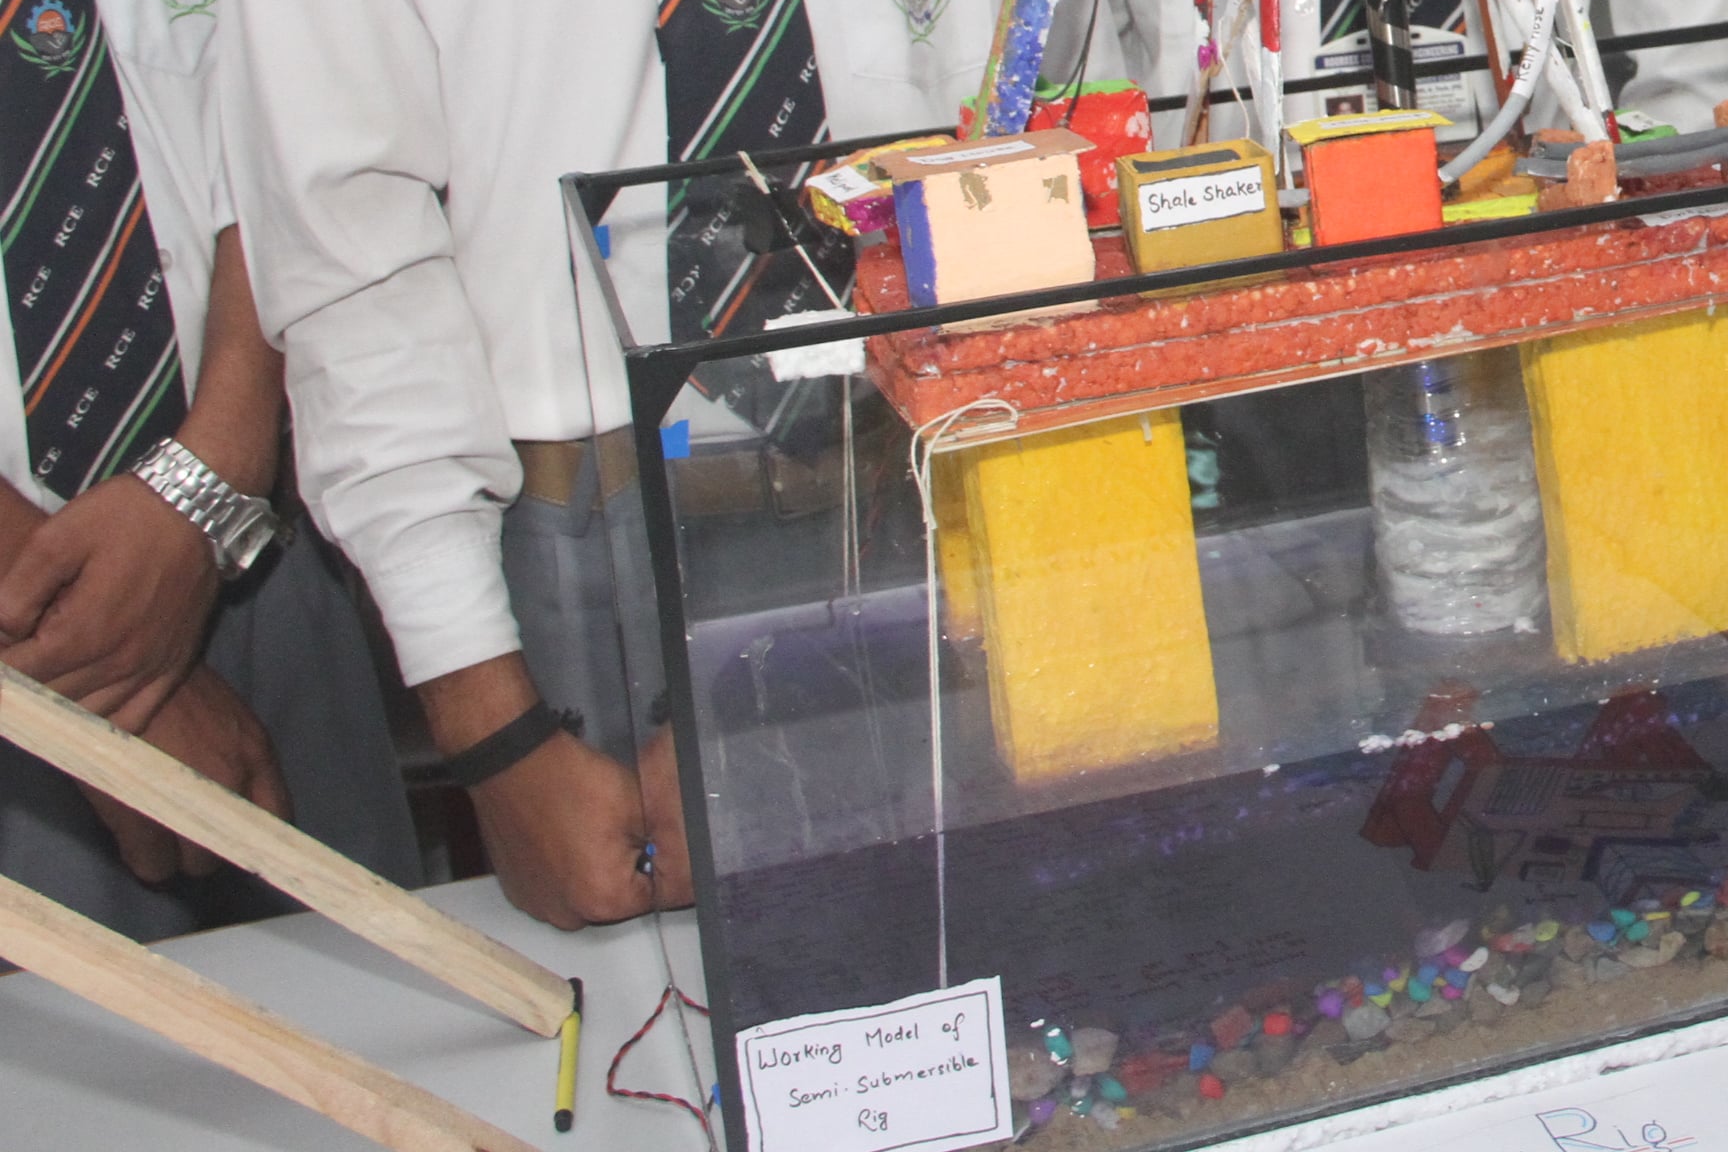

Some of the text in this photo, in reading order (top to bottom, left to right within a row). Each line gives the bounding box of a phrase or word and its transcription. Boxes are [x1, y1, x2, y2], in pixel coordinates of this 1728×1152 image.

[768, 96, 796, 138] RCE
[87, 145, 117, 189] RCE
[1147, 180, 1264, 215] Shale Shaker
[54, 204, 85, 248] RCE
[22, 265, 52, 309] RCE
[137, 266, 165, 312] RCE
[104, 327, 136, 371] RCE
[67, 386, 99, 430] RCE
[757, 1012, 966, 1071] Working Model of
[856, 1053, 980, 1095] Submersible
[857, 1108, 889, 1132] Rig
[1536, 1106, 1673, 1152] Rig
